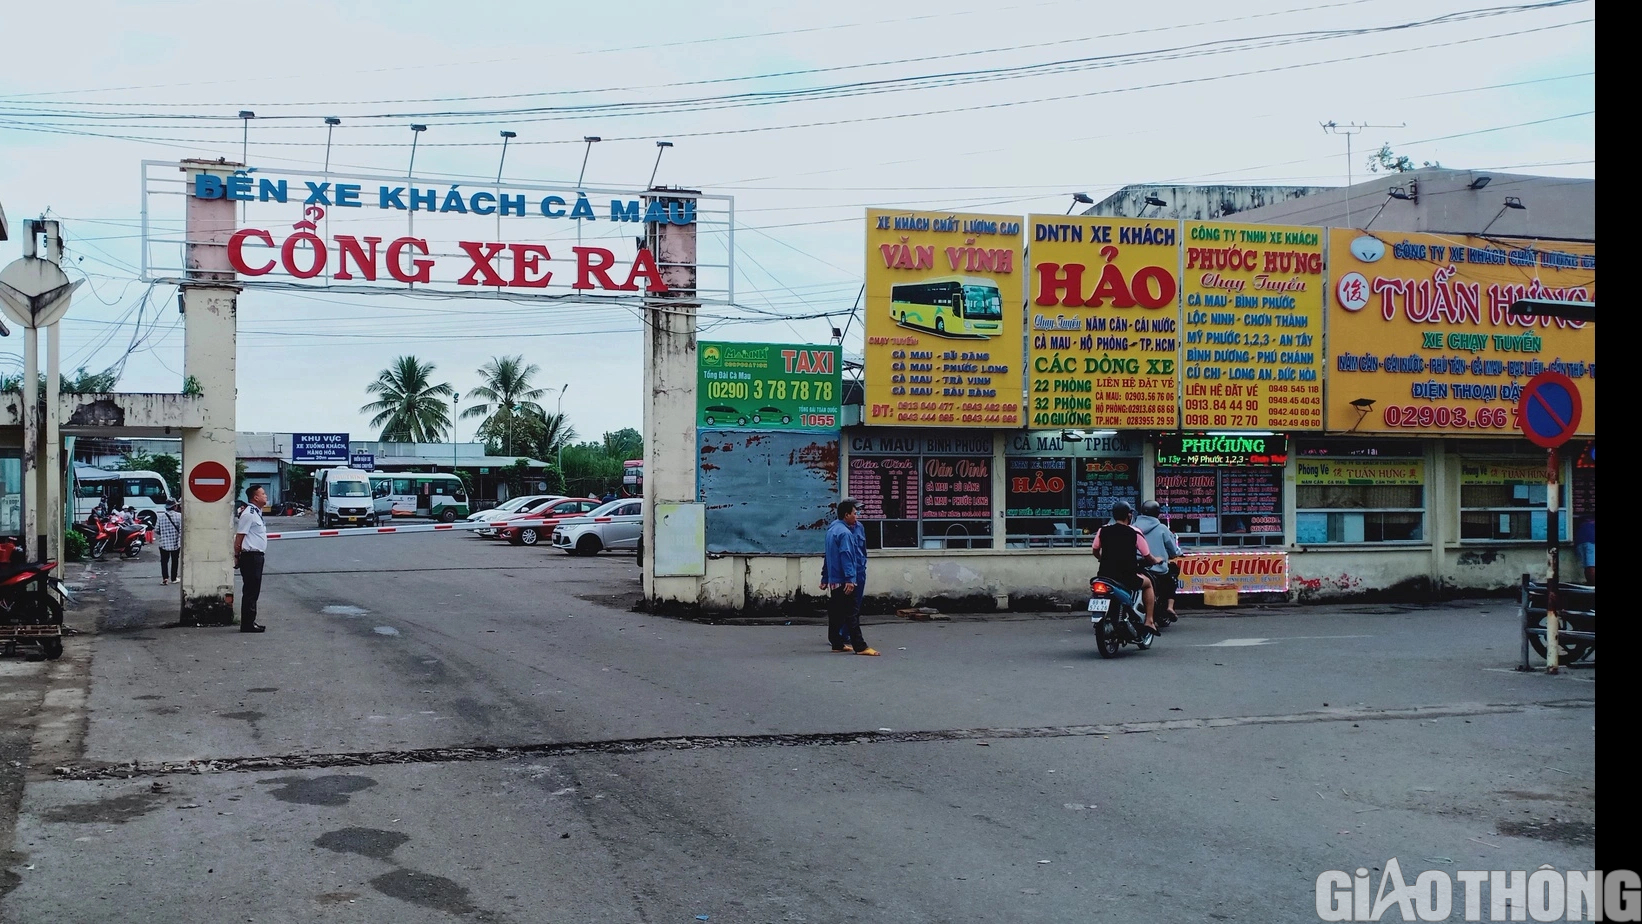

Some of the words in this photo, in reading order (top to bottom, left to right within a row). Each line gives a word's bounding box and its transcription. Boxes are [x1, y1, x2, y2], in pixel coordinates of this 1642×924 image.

[195, 168, 287, 203] BẾN
[304, 181, 361, 207] XE
[380, 184, 525, 217] KHÁCH
[541, 192, 596, 220] CÀ
[610, 200, 694, 225] MAU
[876, 216, 890, 229] XE
[894, 214, 929, 231] KHÁCH
[933, 215, 959, 232] CHẤT
[963, 219, 997, 237] LƯỢNG
[1000, 222, 1019, 235] CAO
[1036, 224, 1082, 242] DNTN
[1091, 226, 1112, 243] XE
[1120, 223, 1175, 246] KHÁCH
[1191, 225, 1220, 240] CÔNG
[1224, 230, 1236, 242] TY
[1240, 230, 1267, 242] TNHH
[1270, 232, 1282, 243] XE
[1284, 230, 1318, 245] KHÁCH
[228, 207, 434, 283] CỔNG
[458, 241, 552, 287] XE
[572, 246, 668, 292] RA
[879, 236, 934, 270] VĂN
[945, 238, 1013, 273] VĨNH
[1394, 240, 1426, 260] CÔNG
[1430, 245, 1445, 261] TY
[1449, 246, 1465, 262] XE
[1468, 245, 1506, 265] KHÁCH
[1186, 244, 1257, 271] PHƯỚC
[1263, 251, 1322, 274] HƯNG
[1035, 246, 1176, 309] HẢO
[1200, 273, 1245, 293] Chạy
[1253, 275, 1307, 293] Tuyến
[1187, 292, 1201, 306] CÀ
[1204, 295, 1227, 306] MAU
[1234, 294, 1258, 308] BÌNH
[1261, 295, 1295, 309] PHƯỚC
[1374, 264, 1480, 326] TUẤN
[1086, 316, 1106, 331] NĂM
[1110, 317, 1127, 331] CĂN
[1135, 316, 1149, 332] CÁI
[1152, 317, 1175, 333] NƯỚC
[1187, 310, 1207, 327] LỘC
[1210, 313, 1235, 325] NINH
[1244, 314, 1272, 326] CHƠN
[1275, 313, 1308, 327] THÀNH
[1034, 333, 1046, 349] CÀ
[1050, 337, 1070, 349] MAU
[1080, 334, 1092, 352] HỘ
[1096, 334, 1128, 350] PHÒNG
[1140, 338, 1175, 352] TP.HCM
[1186, 330, 1203, 343] MỸ
[1206, 330, 1240, 344] PHƯỚC
[1244, 333, 1269, 348] 1,2,3
[1279, 334, 1292, 345] AN
[1295, 332, 1313, 346] TÂY
[1422, 332, 1443, 349] XE
[1448, 332, 1488, 353] CHẠY
[1492, 330, 1541, 352] TUYẾN
[781, 350, 834, 374] TAXI
[892, 361, 905, 371] CÀ
[981, 365, 1008, 373] LONG
[1035, 352, 1077, 373] CÁC
[1084, 353, 1140, 374] DÒNG
[1146, 359, 1174, 374] XE
[730, 371, 737, 379] Cà
[892, 374, 905, 383] CÀ
[1097, 377, 1119, 387] LIÊN
[1122, 377, 1136, 389] HỆ
[1139, 378, 1158, 390] ĐẶT
[1161, 377, 1174, 388] VÉ
[708, 382, 748, 400] (0290)
[754, 380, 762, 399] 3
[768, 380, 786, 400] 78
[791, 381, 809, 400] 78
[814, 382, 832, 400] 78
[1034, 380, 1049, 392] 22
[1054, 377, 1092, 392] PHÒNG
[1186, 384, 1206, 396] LIÊN
[1210, 384, 1222, 398] HỆ
[1226, 384, 1243, 398] ĐẶT
[1247, 384, 1258, 396] VÉ
[1412, 379, 1448, 402] ĐIỆN
[1451, 383, 1497, 403] THOẠI
[1034, 398, 1049, 410] 32
[1054, 395, 1092, 410] PHÒNG
[1096, 390, 1103, 400] CÀ
[872, 404, 893, 417] ĐT:
[1229, 400, 1242, 410] 44
[1246, 400, 1258, 410] 90
[799, 414, 835, 427] 1055
[1034, 413, 1049, 425] 40
[1231, 415, 1243, 426] 72
[1246, 415, 1258, 426] 70
[1384, 405, 1507, 428] 02903.66
[880, 438, 914, 451] MAU
[1014, 434, 1031, 450] CÀ
[1037, 437, 1064, 450] MAU
[1084, 438, 1130, 451] TPHCM
[926, 459, 953, 477] Văn
[1188, 456, 1198, 464] Mỹ
[1012, 471, 1064, 493] HẢO
[1230, 557, 1282, 574] HƯNG
